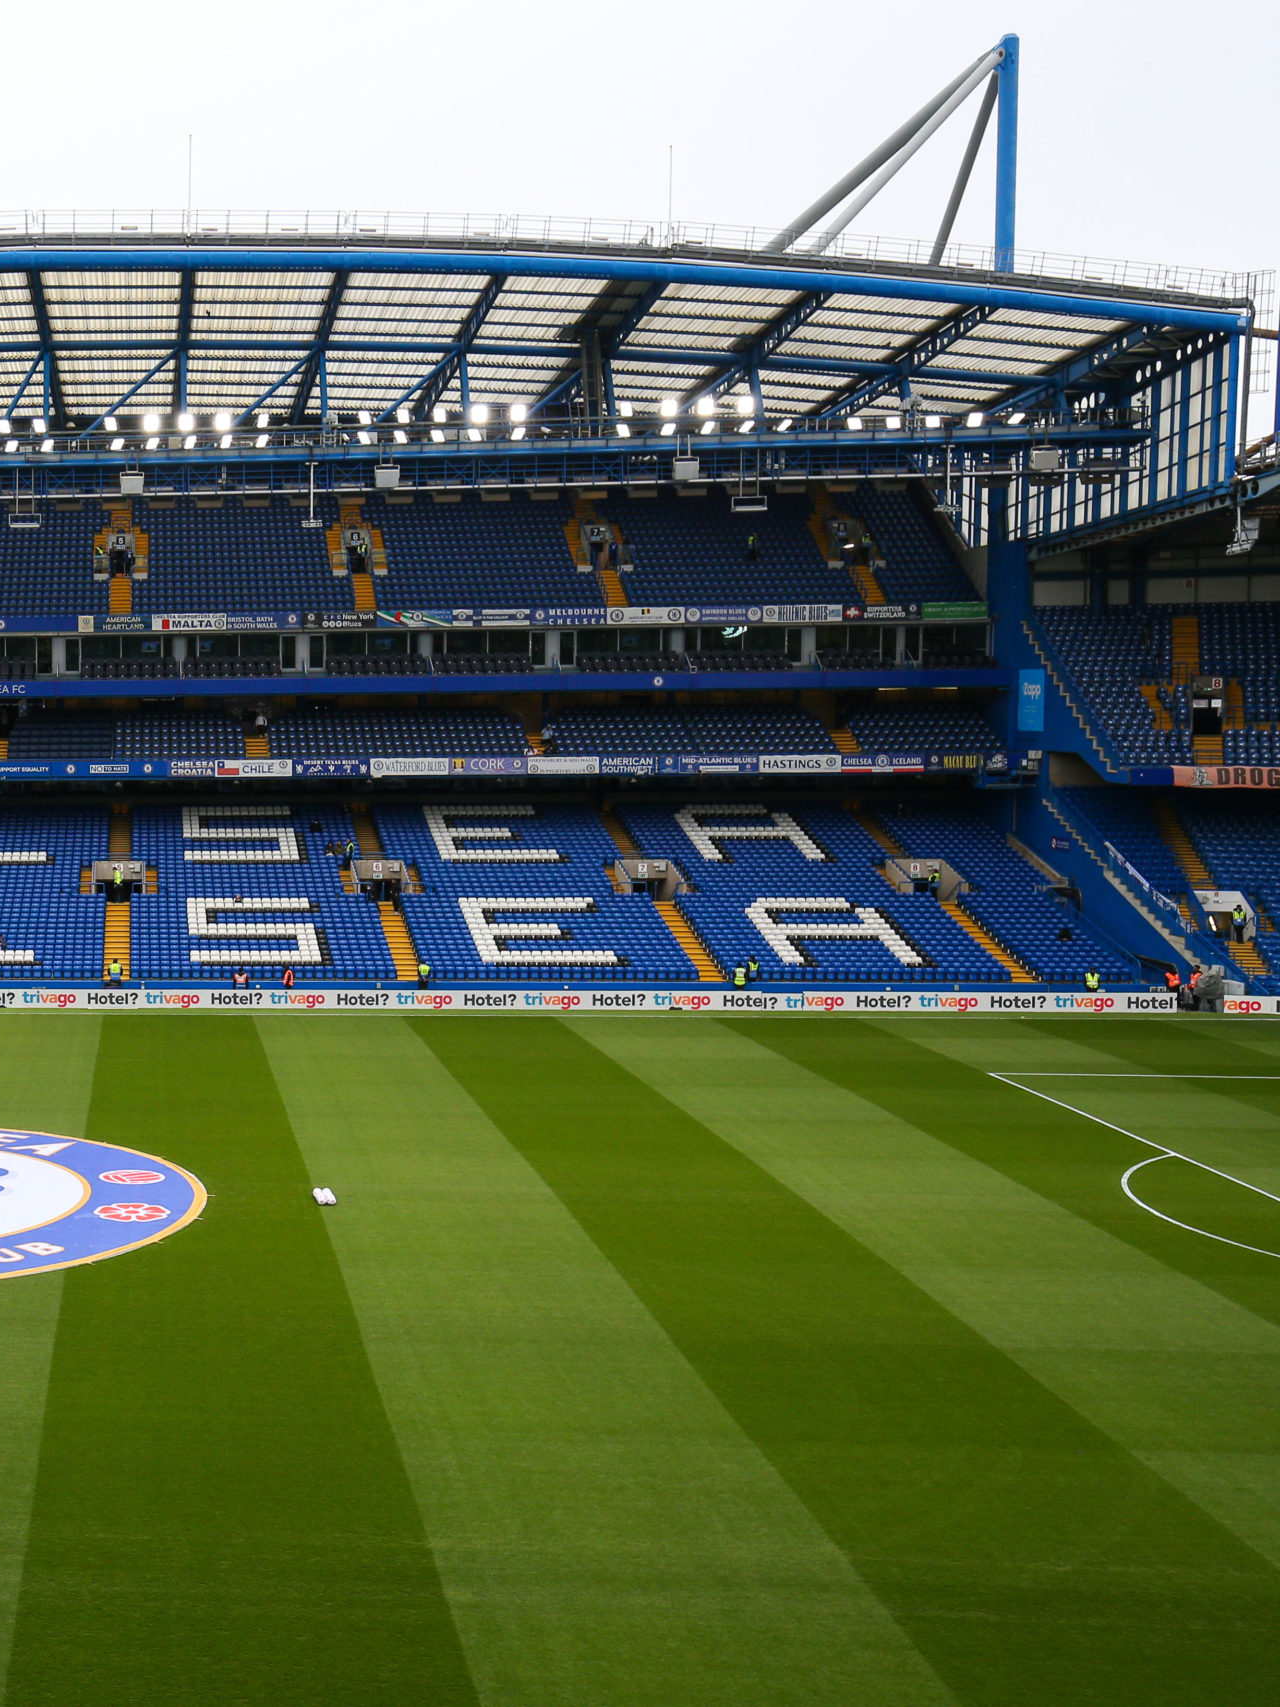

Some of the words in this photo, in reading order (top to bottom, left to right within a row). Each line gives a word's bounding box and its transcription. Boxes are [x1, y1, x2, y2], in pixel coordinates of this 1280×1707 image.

[777, 606, 806, 621] HELLENIC
[808, 605, 828, 621] BLUES
[172, 620, 213, 628] MALTA
[1213, 679, 1221, 688] 8
[12, 684, 26, 694] FC
[1023, 683, 1041, 700] Zapp
[470, 758, 505, 770] CORK
[601, 757, 653, 765] AMERICAN
[763, 760, 821, 768] HASTINGS
[242, 765, 274, 774] CHILE
[385, 760, 426, 772] WATERFORD
[427, 761, 447, 772] BLUES
[601, 765, 653, 773] SOUTHWEST
[171, 768, 213, 776] CROATIA
[1216, 767, 1280, 787] DROG
[22, 991, 76, 1007] trivago
[88, 993, 138, 1004] Hotel?
[146, 991, 199, 1007] trivago
[211, 993, 262, 1005] Hotel?
[270, 992, 325, 1008] trivago
[337, 993, 389, 1005] Hotel?
[396, 992, 452, 1008] trivago
[464, 994, 517, 1006] Hotel?
[524, 993, 580, 1009] trivago
[592, 994, 646, 1006] Hotel?
[653, 993, 710, 1009] trivago
[723, 995, 778, 1008] Hotel?
[785, 994, 844, 1010] trivago
[856, 995, 911, 1007] Hotel?
[919, 994, 978, 1011] trivago
[991, 996, 1046, 1008] Hotel?
[1055, 995, 1114, 1011] trivago
